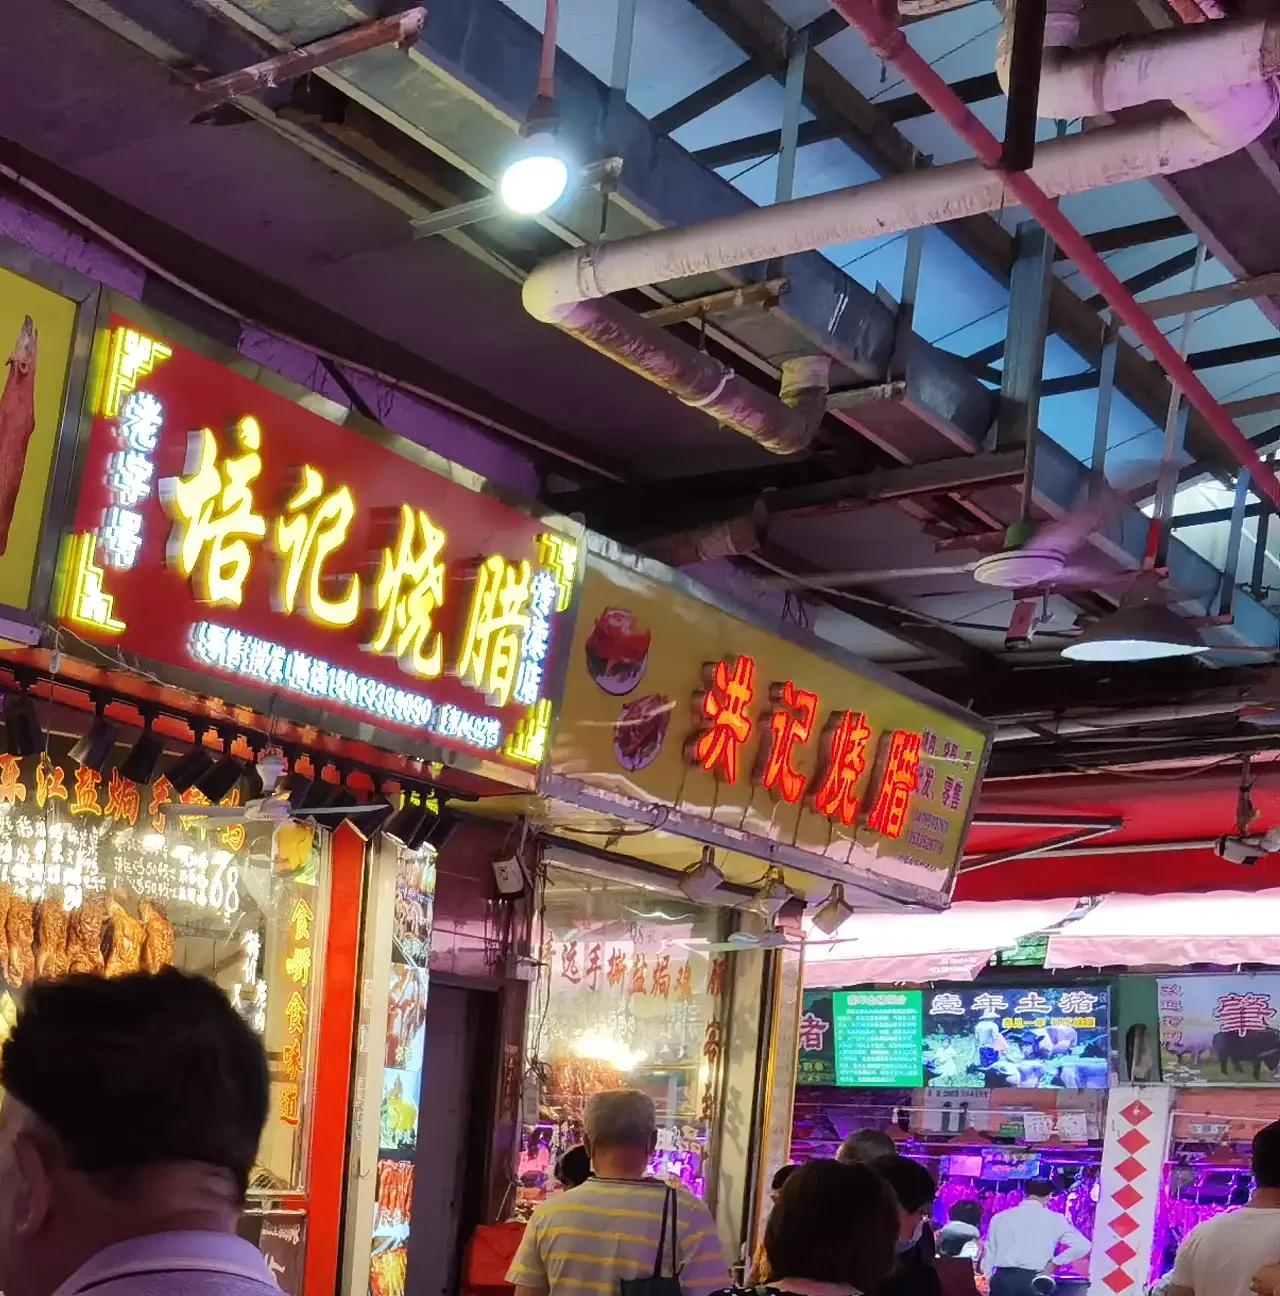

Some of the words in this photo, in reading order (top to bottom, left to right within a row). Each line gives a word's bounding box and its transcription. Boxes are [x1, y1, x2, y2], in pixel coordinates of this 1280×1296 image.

[164, 413, 534, 710] 培记烧腊
[696, 654, 924, 840] 洪记烧腊
